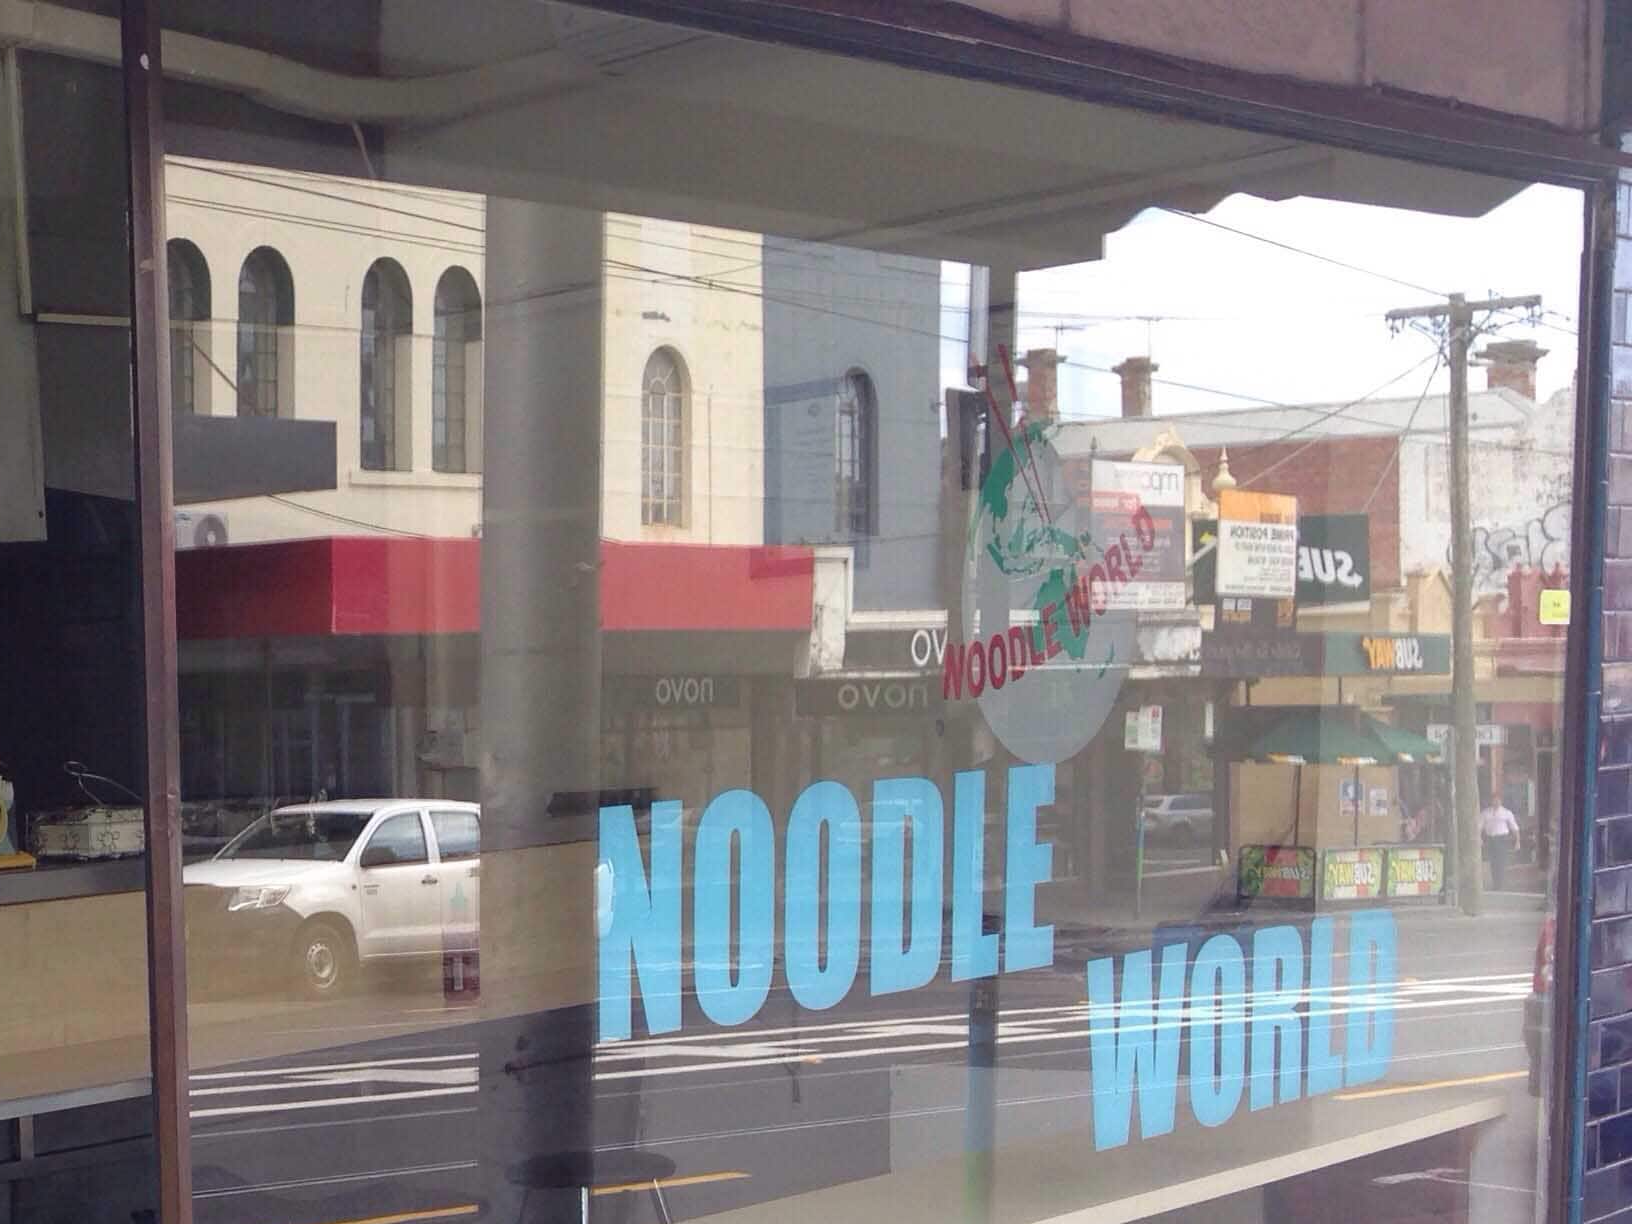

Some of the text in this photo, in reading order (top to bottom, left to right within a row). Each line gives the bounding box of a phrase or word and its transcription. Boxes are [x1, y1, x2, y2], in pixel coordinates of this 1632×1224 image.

[944, 603, 1063, 700] NOODLE
[1065, 506, 1155, 637] WORLD
[599, 762, 1055, 1042] NOODLE
[1087, 907, 1399, 1151] WORLD
